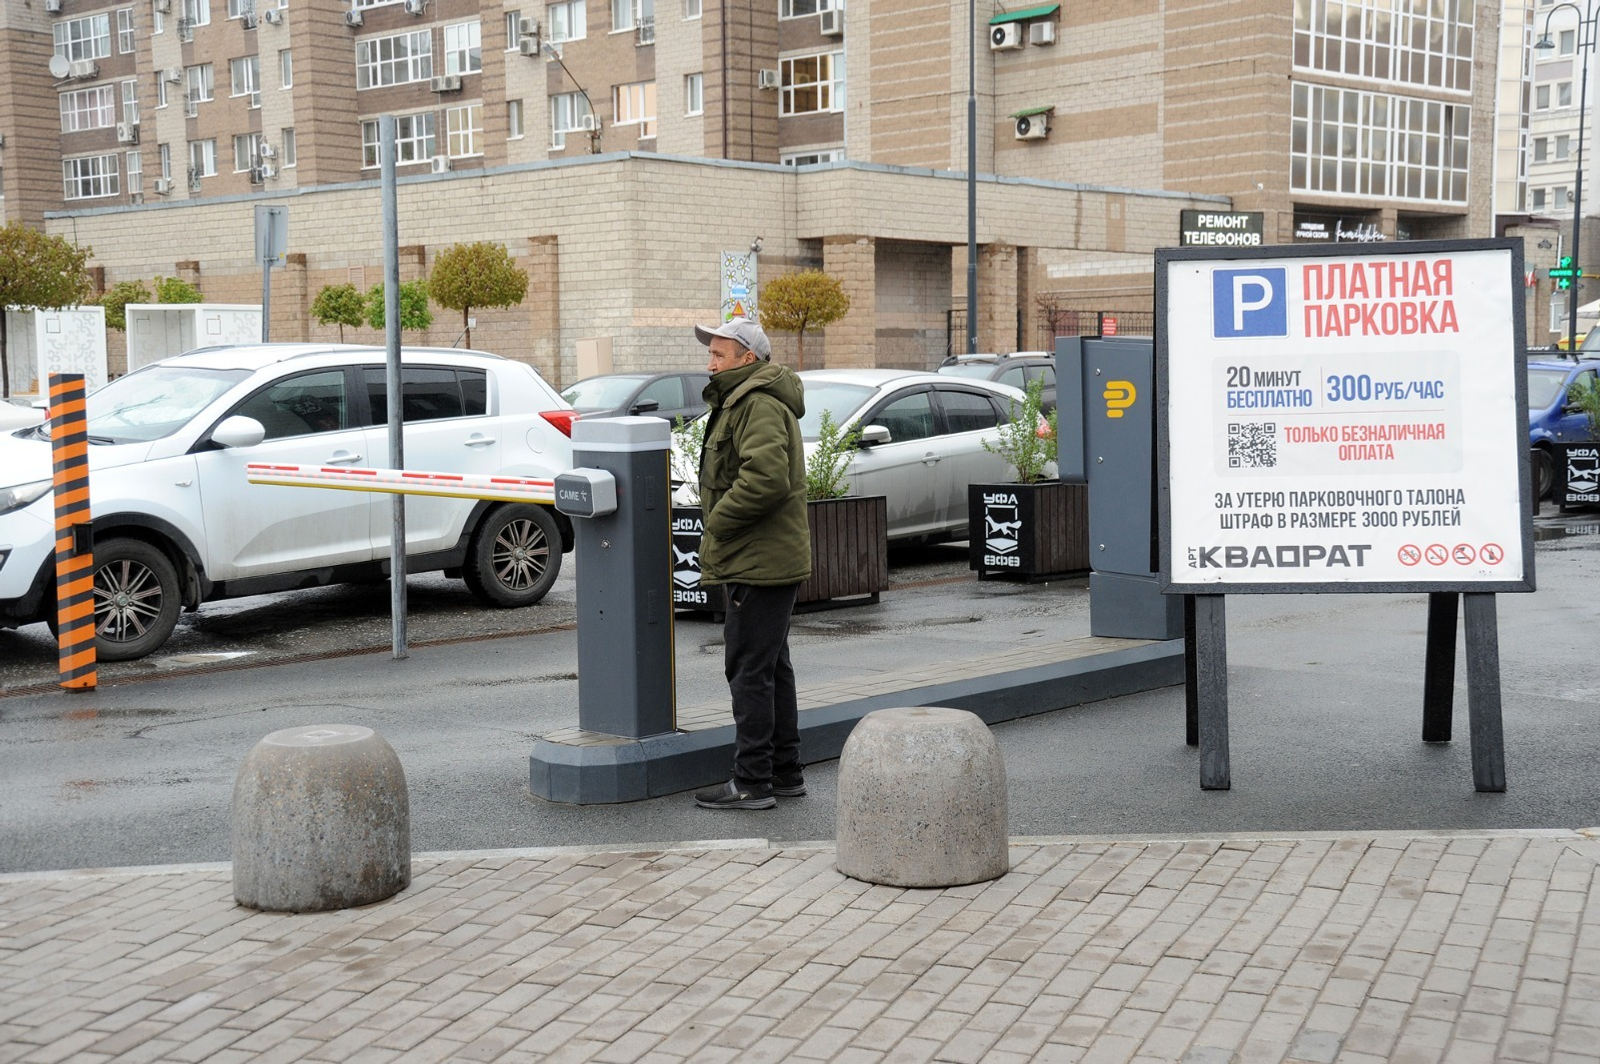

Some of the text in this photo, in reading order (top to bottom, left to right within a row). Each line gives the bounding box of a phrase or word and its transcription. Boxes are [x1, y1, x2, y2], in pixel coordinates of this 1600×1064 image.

[1198, 214, 1249, 229] РЕМОНТ
[1184, 231, 1261, 246] ТЕЛЕФОНОВ
[1303, 259, 1453, 300] ПЛАТНАЯ
[1233, 275, 1273, 330] P
[1304, 300, 1459, 338] ПАРКОВКА
[1227, 366, 1302, 388] 20 МИНУТ
[1326, 374, 1444, 402] 300 РУБ/ЧАС
[1227, 389, 1313, 409] БЕСПЛАТНО
[1284, 423, 1445, 444] ТОЛЬКО БЕЗНАЛИЧНАЯ
[1338, 444, 1394, 462] ОПЛАТА
[1566, 449, 1599, 457] УФА
[560, 490, 580, 501] CAME
[983, 493, 1018, 504] УФА
[1214, 488, 1466, 509] ЗА УТЕРЮ ПАРКОВОЧНОГО ТАЛОНА
[1220, 508, 1461, 530] ШТРАФ В РАЗМЕРЕ 3000 РУБЛЕЙ
[1187, 546, 1198, 569] АРТ
